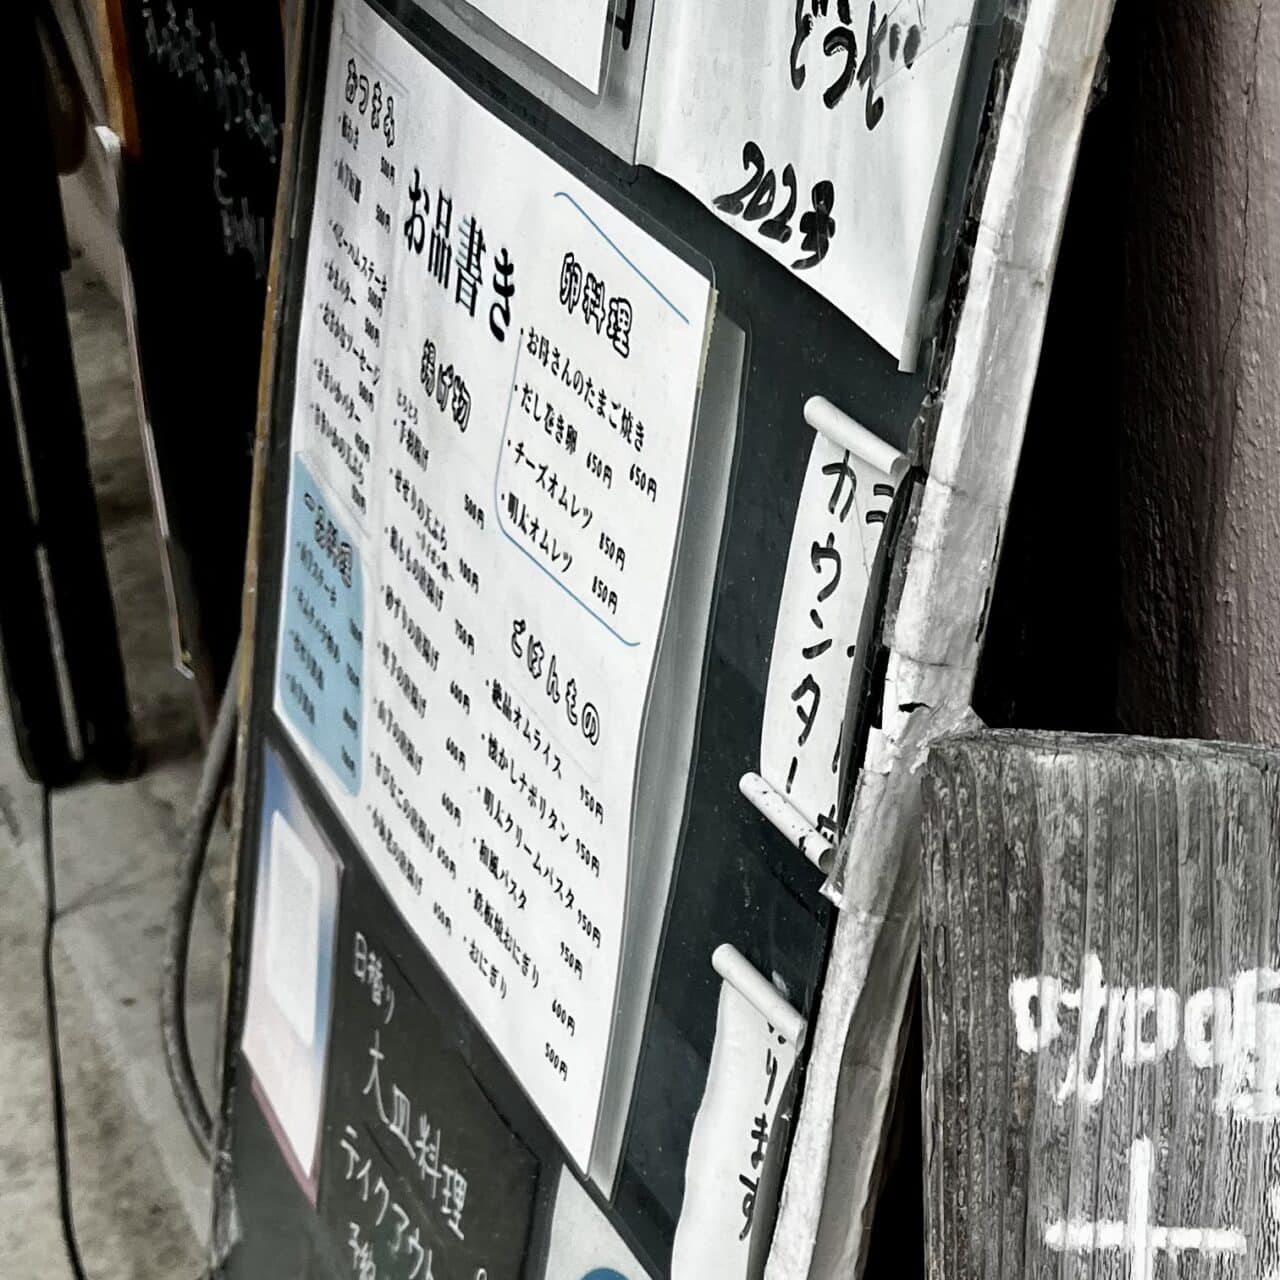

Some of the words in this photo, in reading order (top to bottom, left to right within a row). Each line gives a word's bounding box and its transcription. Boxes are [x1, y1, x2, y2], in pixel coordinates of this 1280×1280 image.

[344, 57, 395, 148] おつまみ
[404, 165, 515, 343] お品書き
[559, 252, 633, 359] 卵料理
[420, 338, 471, 433] 揚げ物
[521, 382, 578, 455] だし巻き卵
[586, 451, 612, 490] 650円
[527, 326, 644, 452] お母さんのたまご焼き
[629, 464, 657, 503] 650円
[304, 492, 352, 588] 一品料理
[394, 469, 447, 551] せせりの天ぷら
[508, 491, 572, 573] 明太オムレツ
[592, 576, 617, 615] 850円
[515, 442, 593, 529] チーズオムレツ
[599, 532, 625, 572] 850円
[511, 619, 600, 746] ごはんもの
[788, 450, 858, 794] カウンター
[488, 732, 569, 842] 懐かしナポリタン
[576, 838, 600, 878] 950円
[492, 678, 561, 779] 絶品オムライス
[580, 784, 603, 824] 950円
[479, 839, 527, 910] 和風パスタ
[560, 941, 582, 980] 950円
[483, 787, 574, 910] 明太クリームパスタ
[578, 909, 601, 949] 950円
[353, 931, 395, 1024] 日替り
[469, 940, 506, 999] おにぎり
[545, 1042, 568, 1081] 500円
[473, 888, 539, 988] 鉄板焼おにぎり
[552, 999, 575, 1037] 600円
[362, 1029, 467, 1240] 大皿料理
